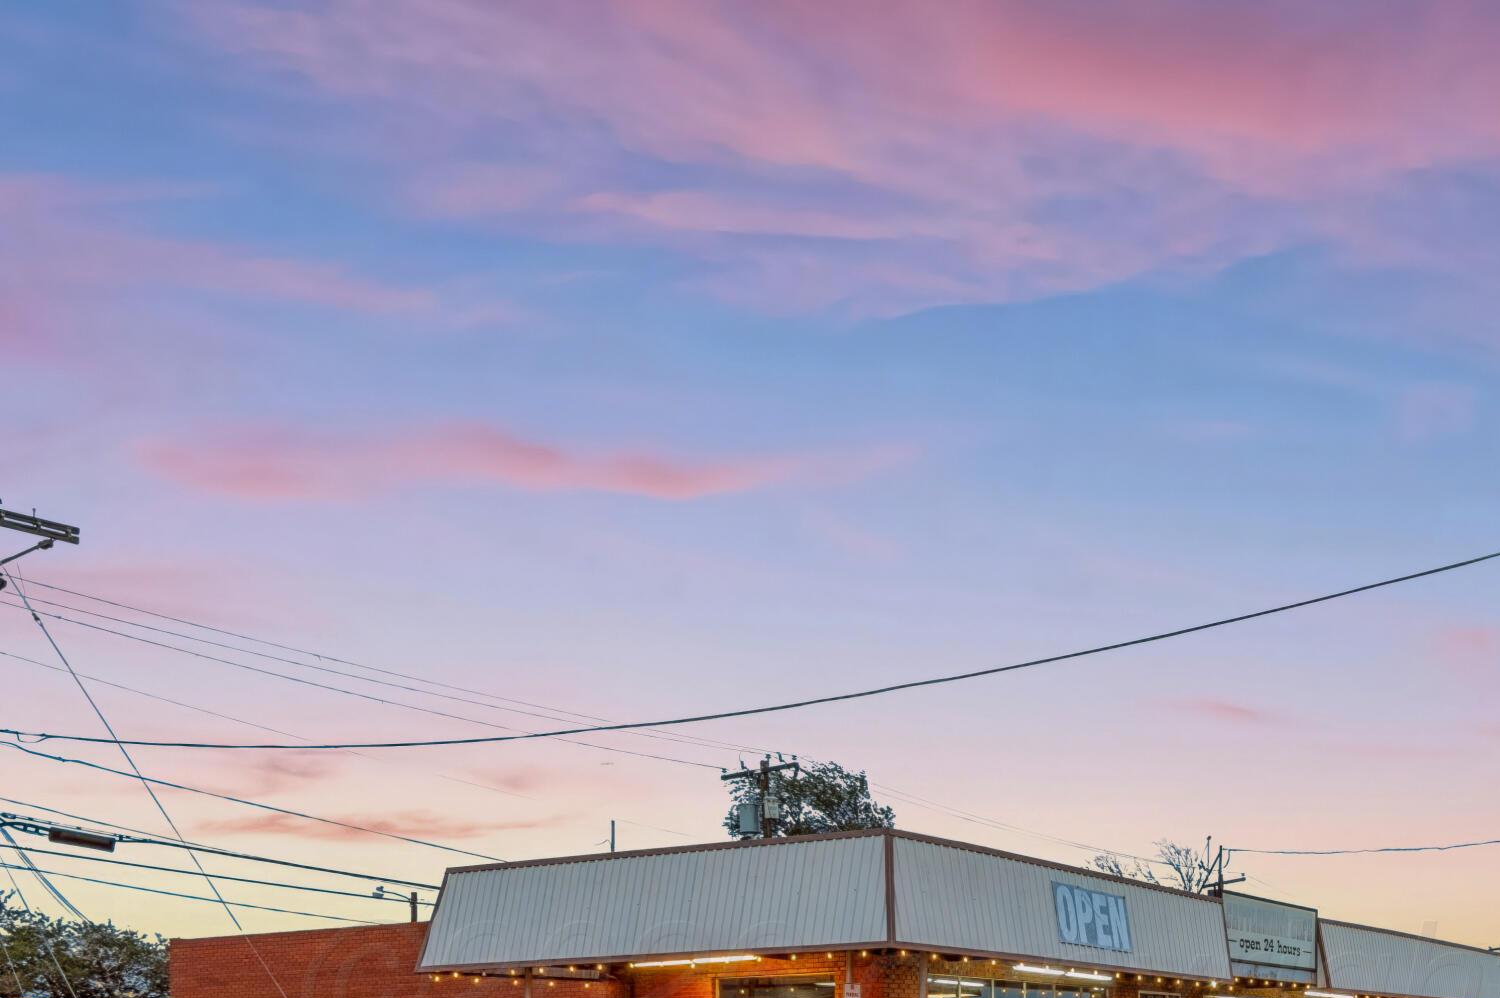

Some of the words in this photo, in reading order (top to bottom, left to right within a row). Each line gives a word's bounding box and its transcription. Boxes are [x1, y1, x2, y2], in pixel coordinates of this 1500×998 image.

[1056, 885, 1131, 949] OPEN
[1239, 939, 1261, 953] open
[1264, 938, 1274, 951] 24
[1277, 940, 1300, 956] hours
